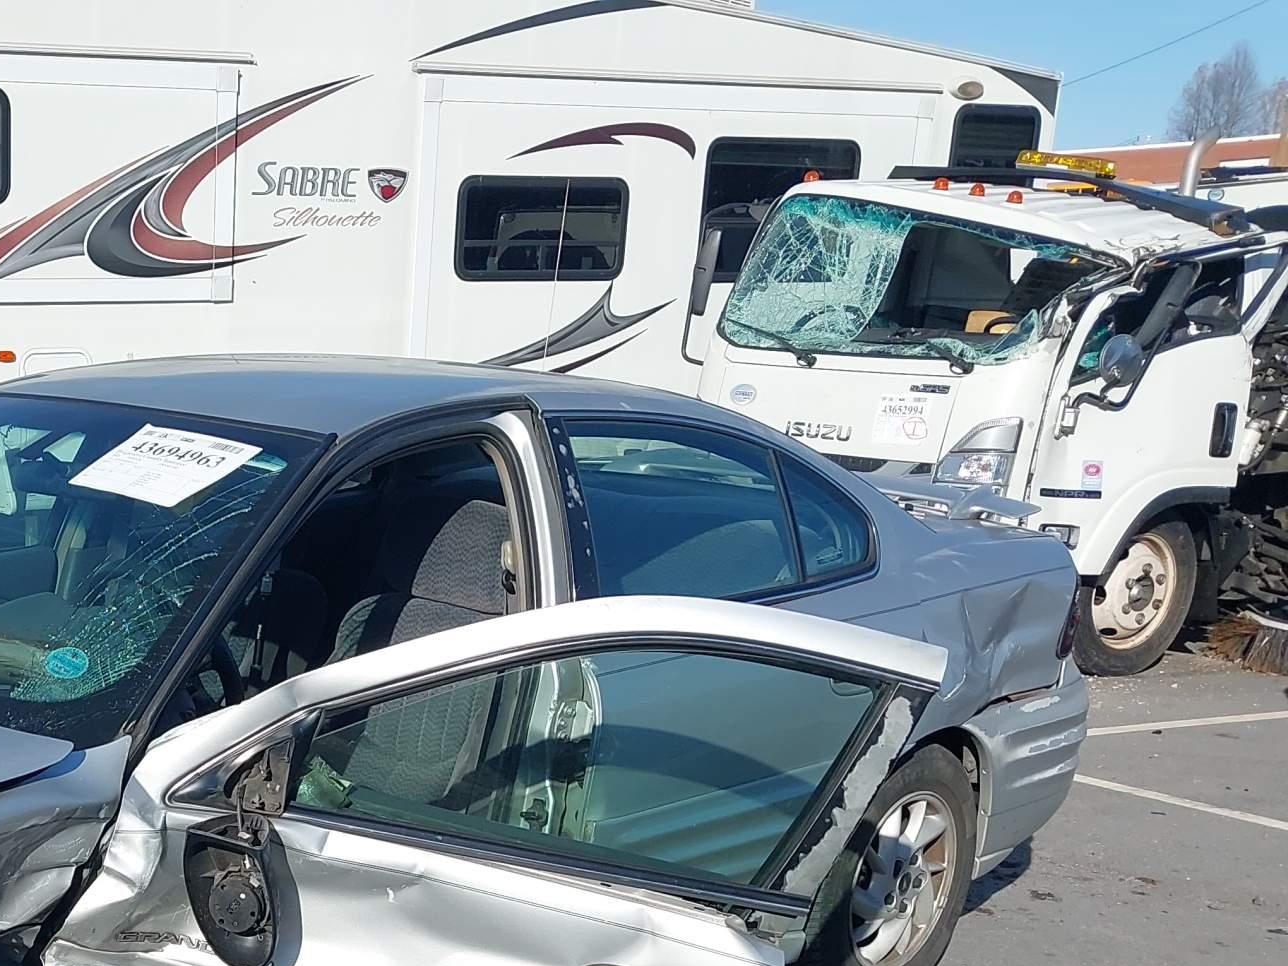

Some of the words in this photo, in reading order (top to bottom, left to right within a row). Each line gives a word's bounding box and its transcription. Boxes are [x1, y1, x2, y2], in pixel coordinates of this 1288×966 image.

[252, 161, 360, 197] SABRE
[272, 206, 382, 228] Silhouette
[881, 404, 924, 417] 43652994
[784, 420, 853, 442] ISUZU
[132, 441, 226, 468] 43694963
